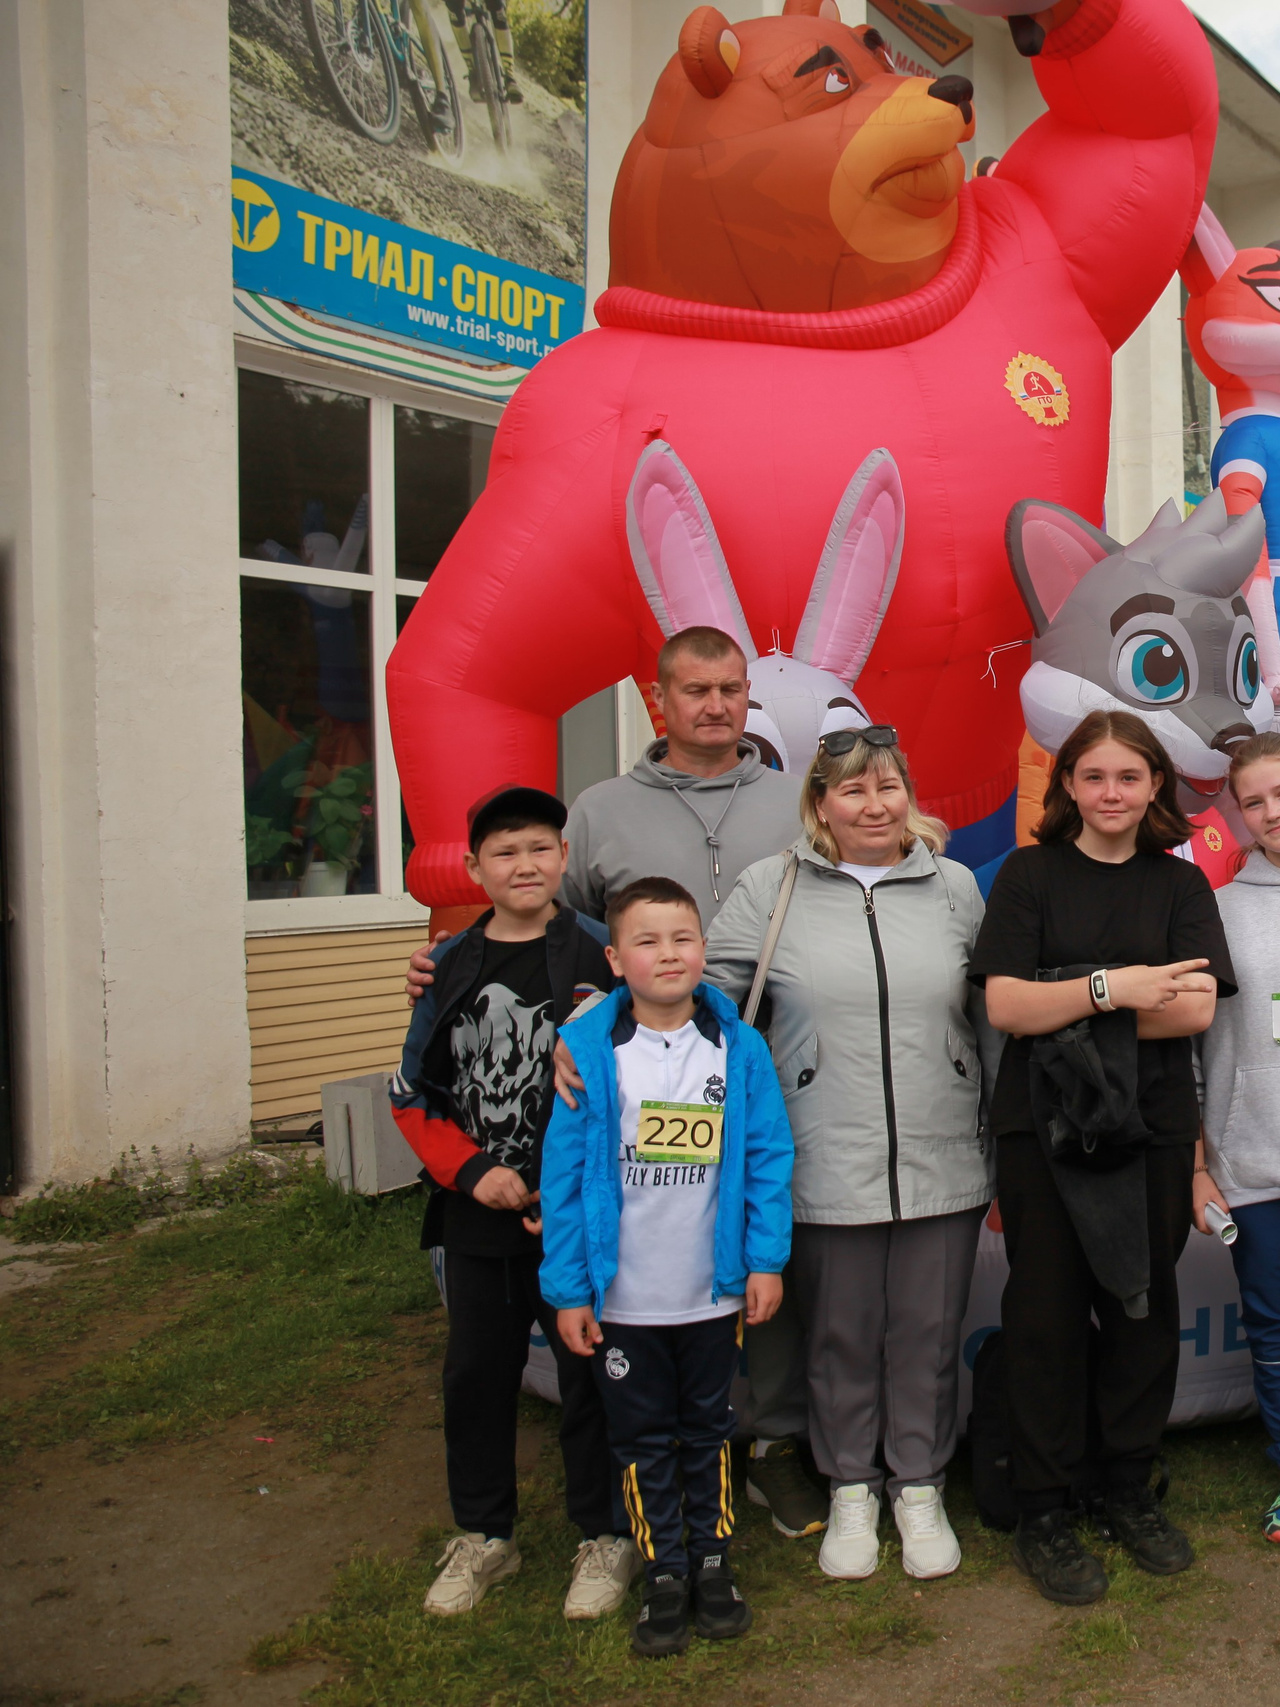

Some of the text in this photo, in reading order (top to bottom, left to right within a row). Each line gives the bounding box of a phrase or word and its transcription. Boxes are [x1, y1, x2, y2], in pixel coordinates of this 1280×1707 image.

[407, 303, 556, 359] www.trial-sport.r
[1037, 396, 1053, 405] ГТО
[643, 1116, 714, 1149] 220
[625, 1165, 706, 1186] FLY BETTER
